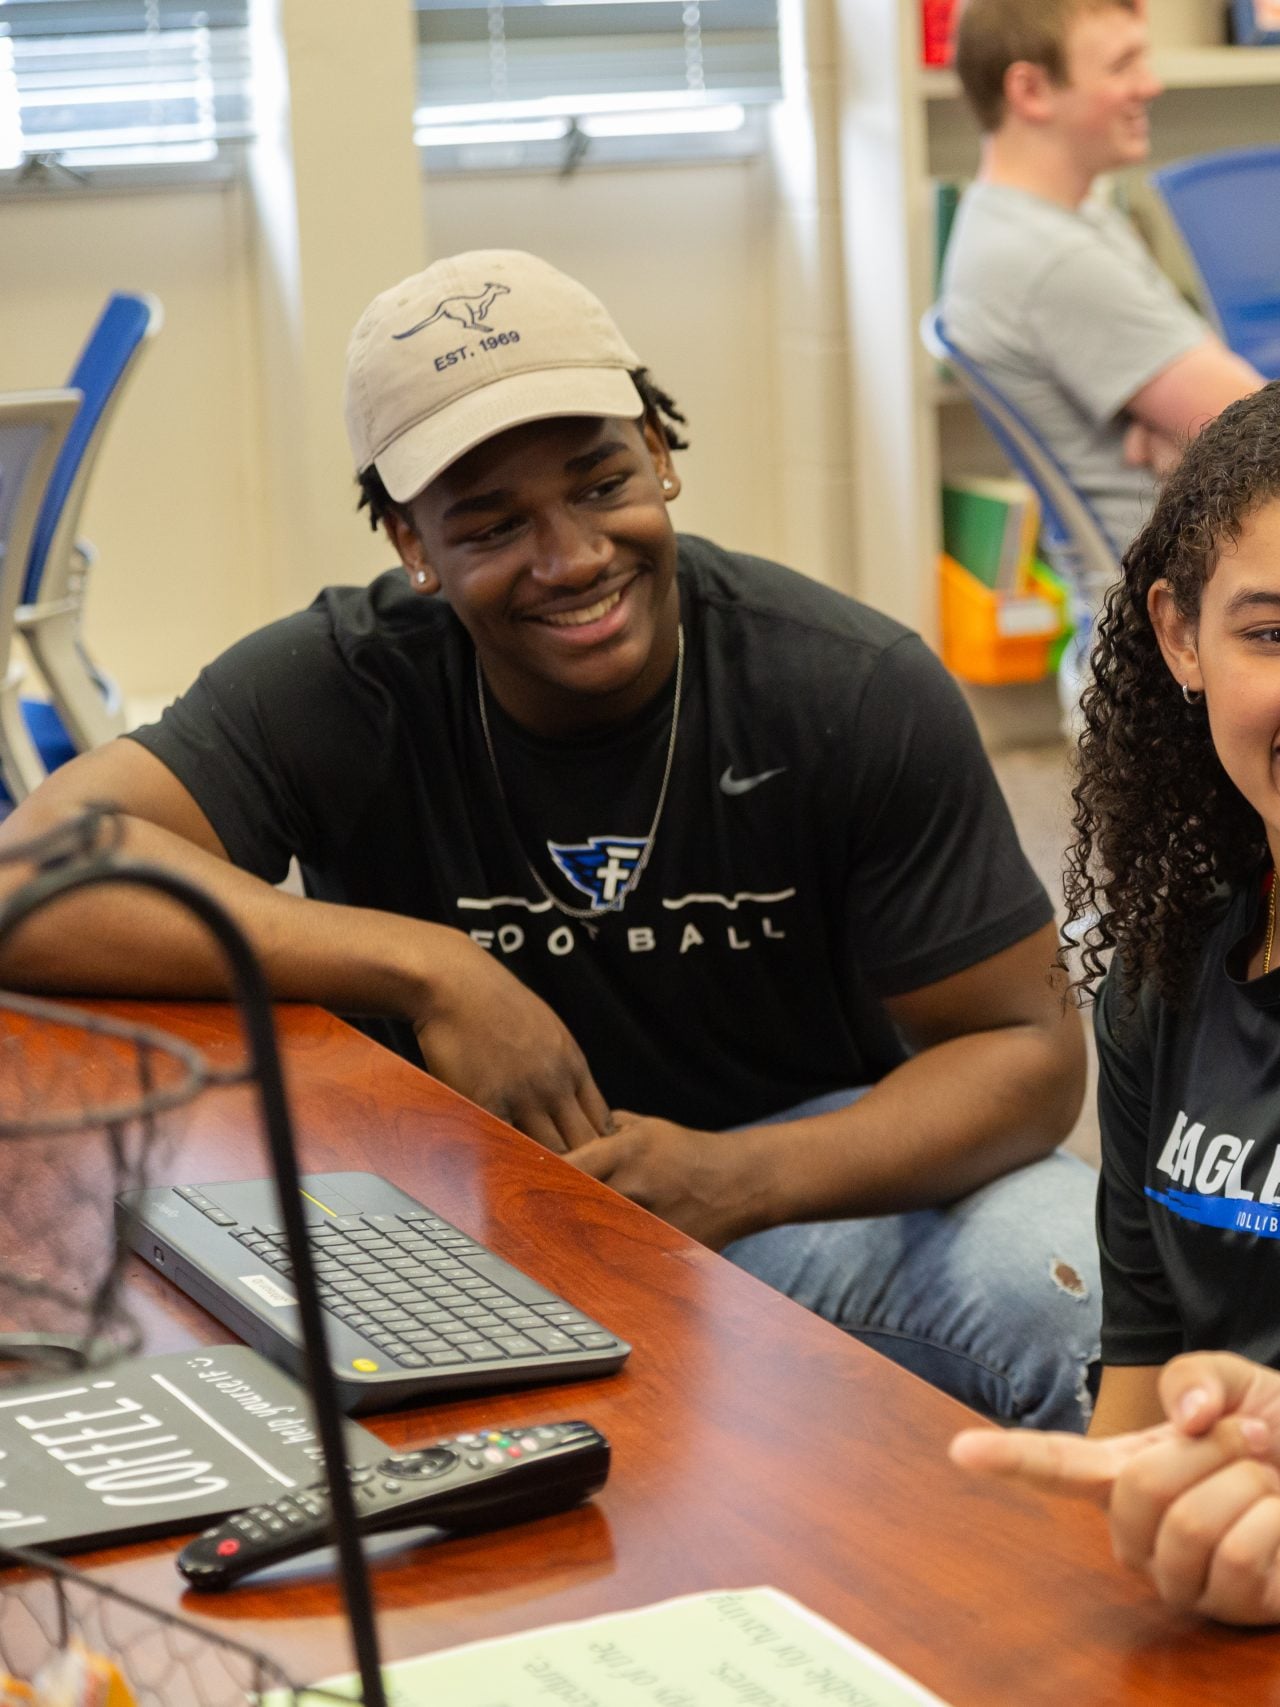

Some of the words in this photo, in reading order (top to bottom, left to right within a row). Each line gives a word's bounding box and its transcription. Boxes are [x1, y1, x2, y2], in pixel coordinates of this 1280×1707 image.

[434, 345, 475, 372] EST.
[479, 331, 520, 352] 1969
[0, 1381, 229, 1507] COFFEE!
[267, 1417, 316, 1445] help
